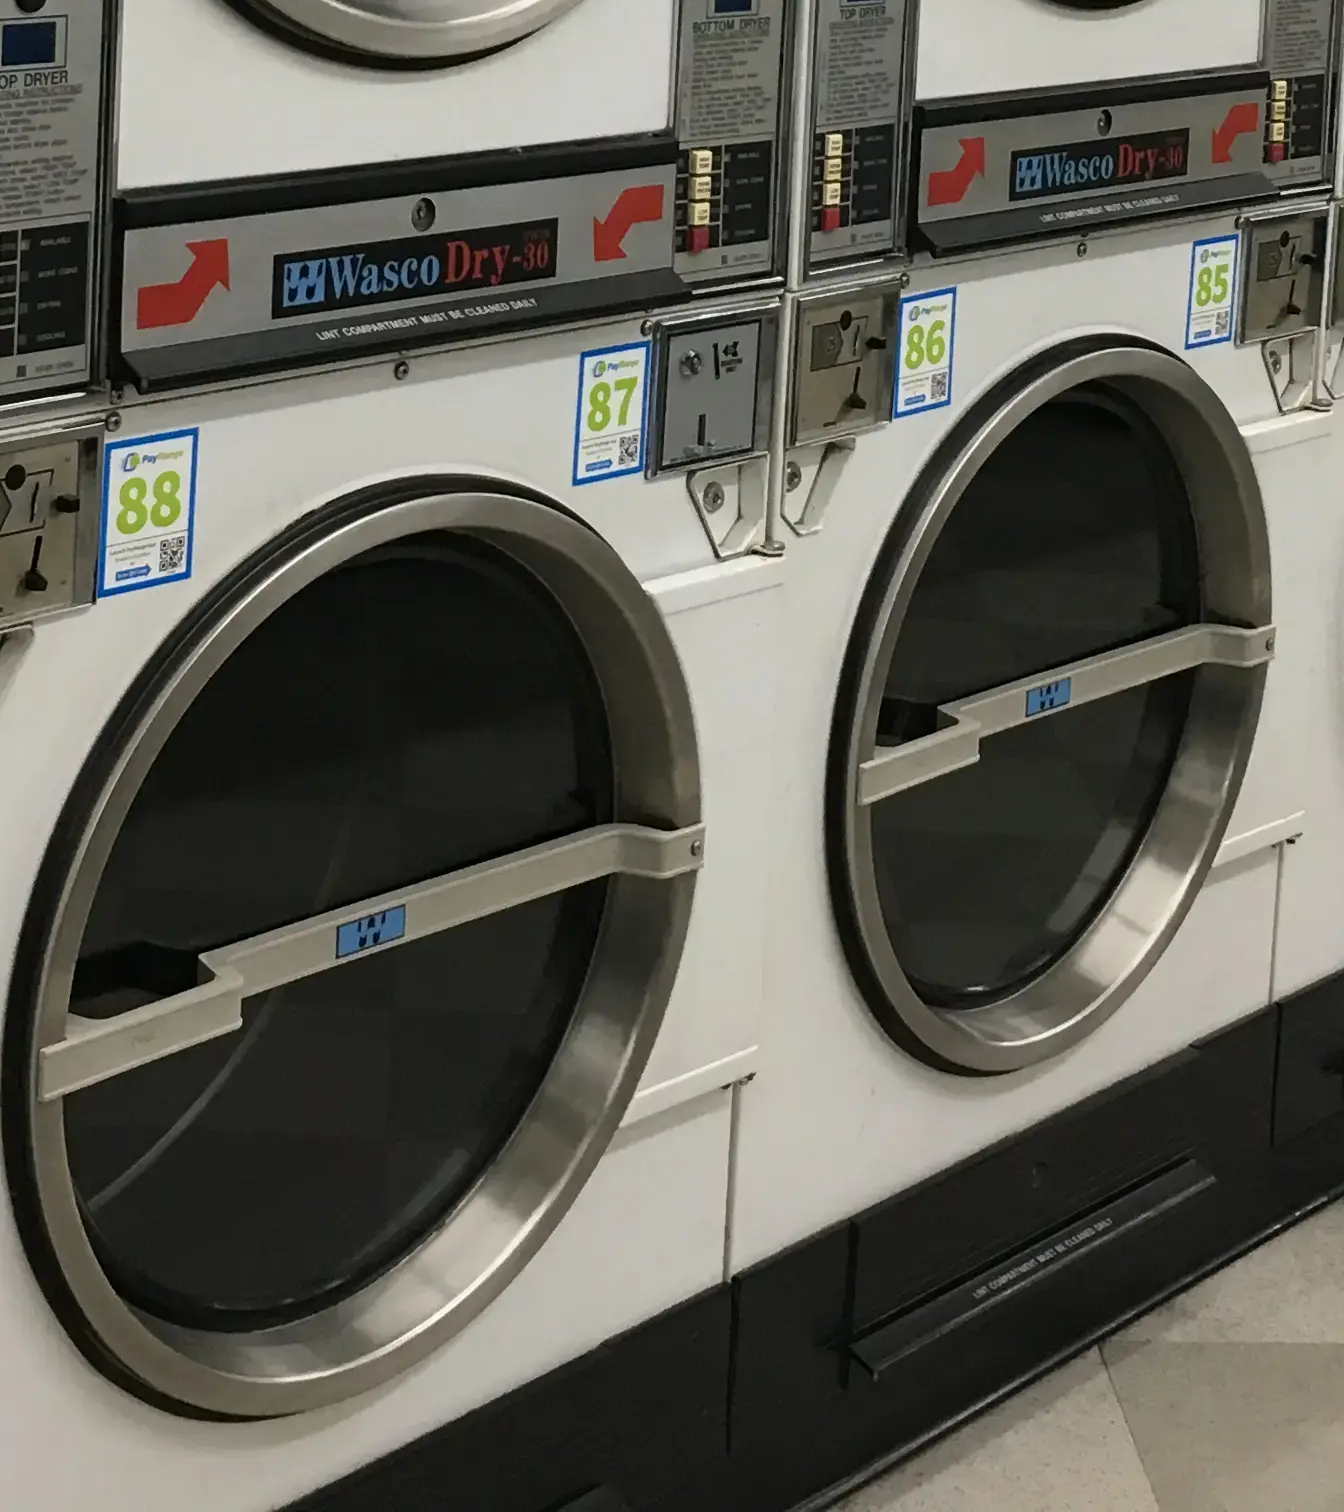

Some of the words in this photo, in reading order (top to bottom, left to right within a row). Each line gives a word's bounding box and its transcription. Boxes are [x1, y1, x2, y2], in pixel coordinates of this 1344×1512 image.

[692, 19, 735, 34] BOTTOM
[739, 16, 771, 30] DRYER
[23, 69, 69, 88] DRYER
[1043, 150, 1115, 189] Wasco
[326, 251, 442, 300] Wasco
[443, 239, 550, 285] Dry-30
[1195, 263, 1229, 307] 85
[316, 330, 342, 342] LINT
[341, 316, 420, 339] COMPARTMENT
[419, 311, 450, 325] MUST
[449, 309, 465, 321] BE
[904, 319, 946, 370] 86
[586, 375, 639, 432] 87
[141, 449, 185, 465] PayRange
[115, 469, 182, 535] 88
